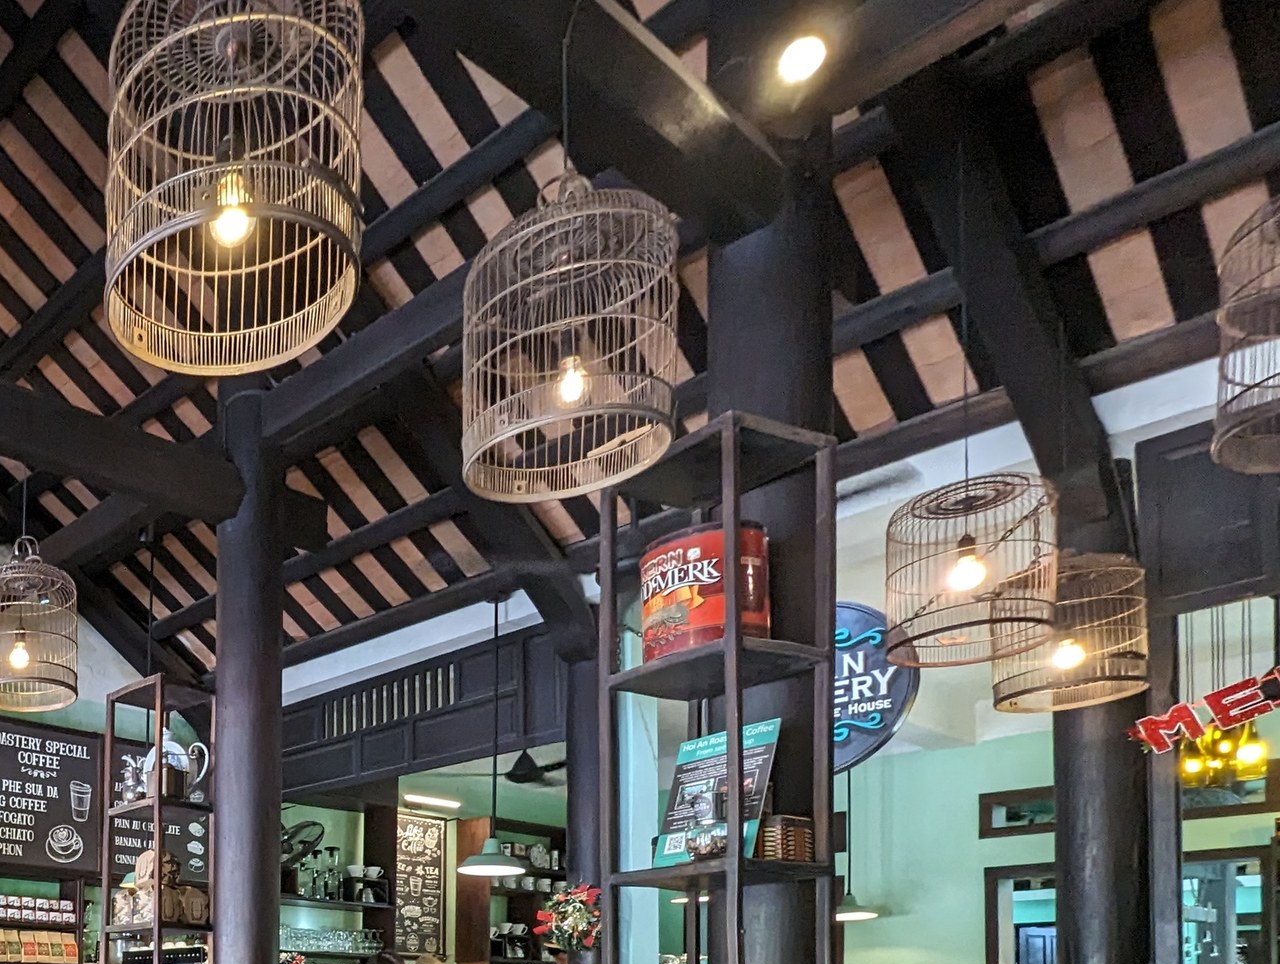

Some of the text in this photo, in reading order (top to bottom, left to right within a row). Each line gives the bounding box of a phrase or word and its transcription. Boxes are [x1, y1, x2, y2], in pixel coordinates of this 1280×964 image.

[835, 651, 865, 678] N
[834, 665, 898, 704] ERY
[848, 699, 892, 715] HOUSE
[1135, 677, 1280, 754] ME
[683, 743, 696, 752] Hoi
[697, 740, 708, 749] An
[745, 724, 775, 737] Coffee
[45, 740, 90, 759] SPECIAL
[17, 751, 60, 769] COFFEE
[2, 779, 22, 793] PHE
[25, 782, 43, 796] SUA
[47, 786, 59, 798] DA
[9, 796, 47, 812] COFFEE
[114, 818, 130, 829] PAIN
[132, 820, 140, 829] AU
[115, 836, 142, 848] BANANA
[424, 866, 439, 875] TEA
